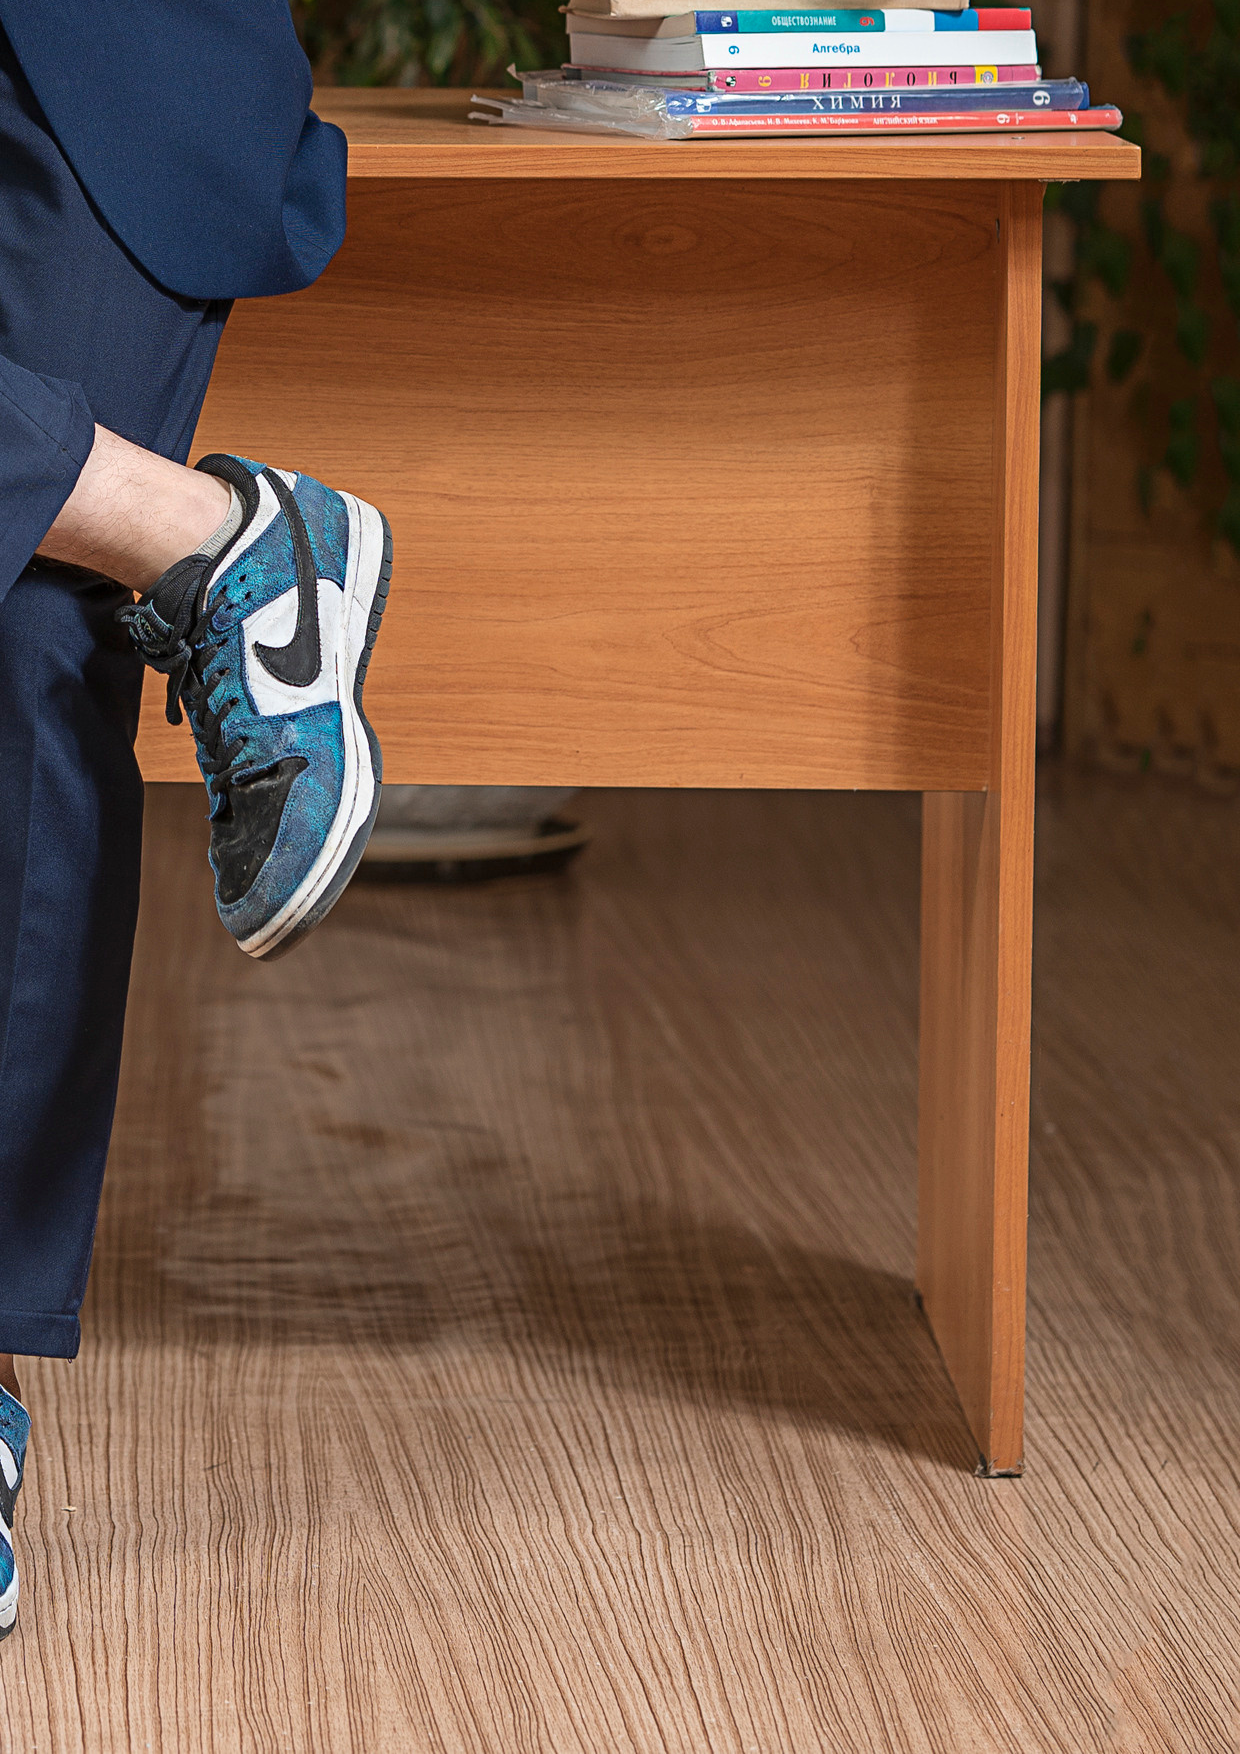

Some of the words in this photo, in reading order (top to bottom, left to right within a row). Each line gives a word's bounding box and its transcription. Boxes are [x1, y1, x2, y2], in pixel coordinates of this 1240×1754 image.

[772, 15, 836, 27] ОБЩЕСТВОЗНАНИЕ
[728, 45, 740, 55] 6
[812, 43, 860, 54] Алгебра
[799, 71, 957, 88] БИОЛОГИЯ
[812, 94, 902, 110] ХИМИЯ
[1033, 90, 1051, 106] 6
